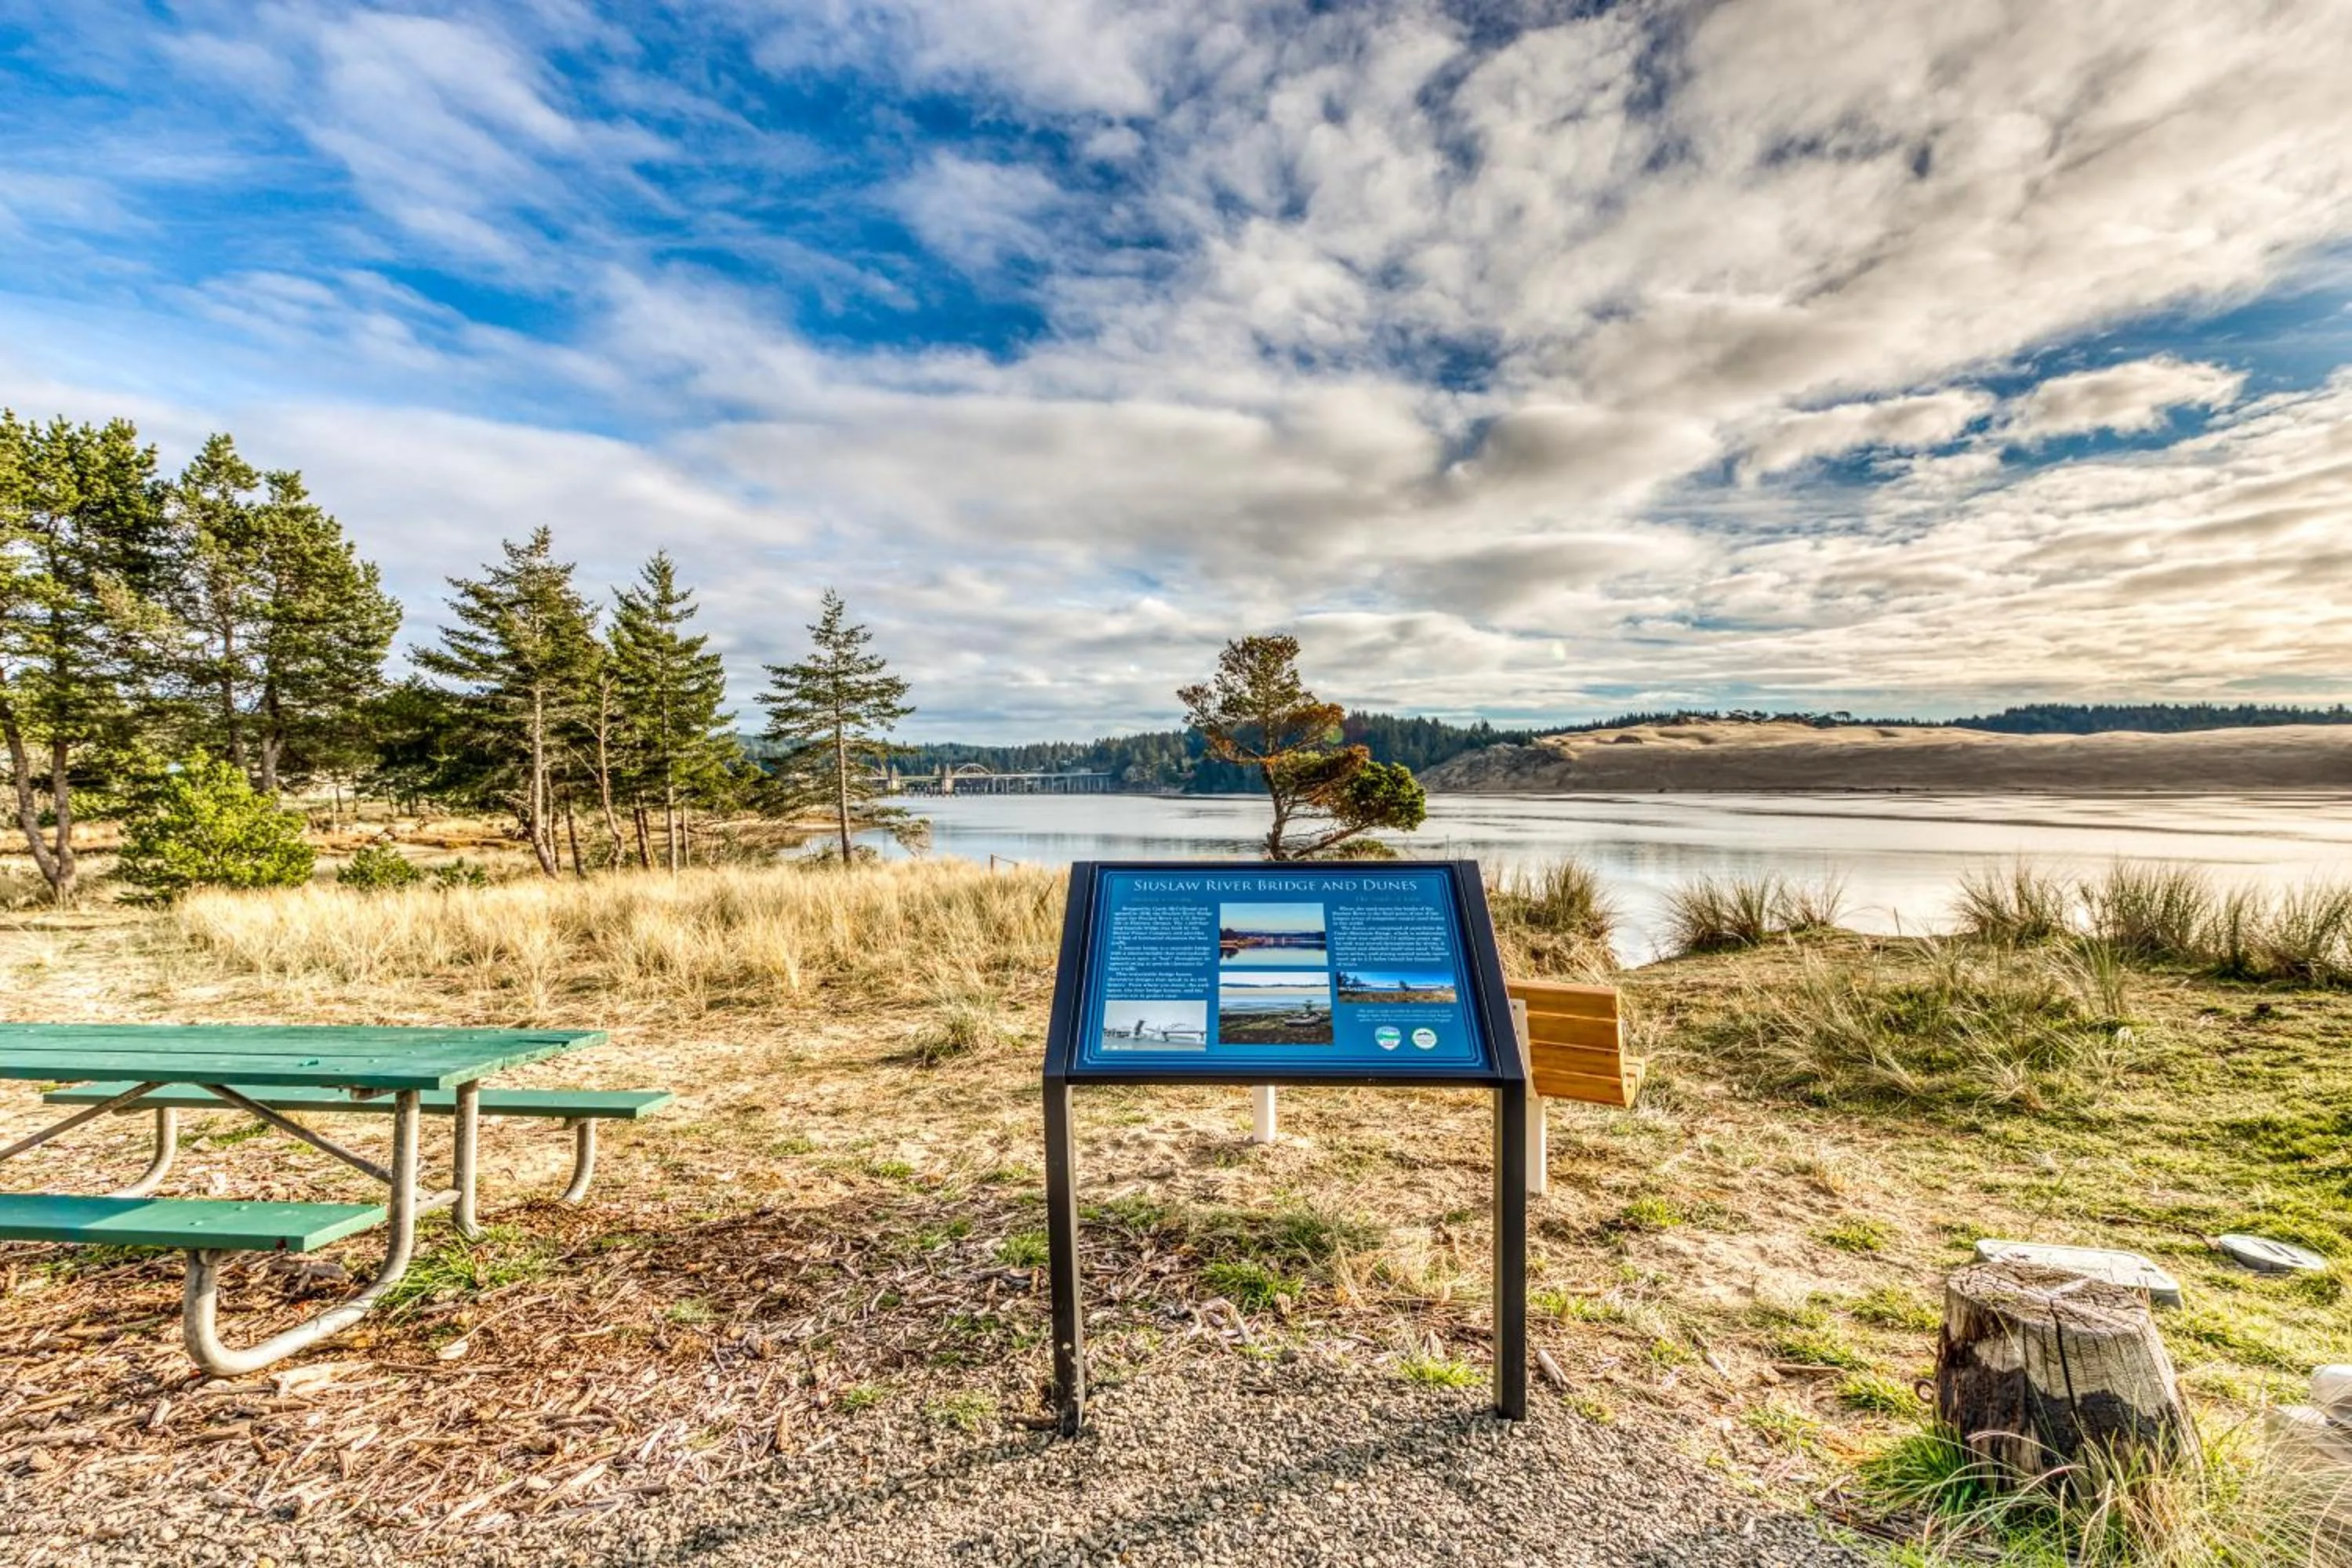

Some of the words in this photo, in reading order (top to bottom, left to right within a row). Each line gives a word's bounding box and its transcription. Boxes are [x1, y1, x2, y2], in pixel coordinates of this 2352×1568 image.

[1134, 880, 1200, 891] SIUSLAW
[1207, 880, 1252, 891] RIVER
[1258, 880, 1318, 891] BRIDGE
[1322, 880, 1357, 891] AND
[1363, 880, 1417, 891] DUNES
